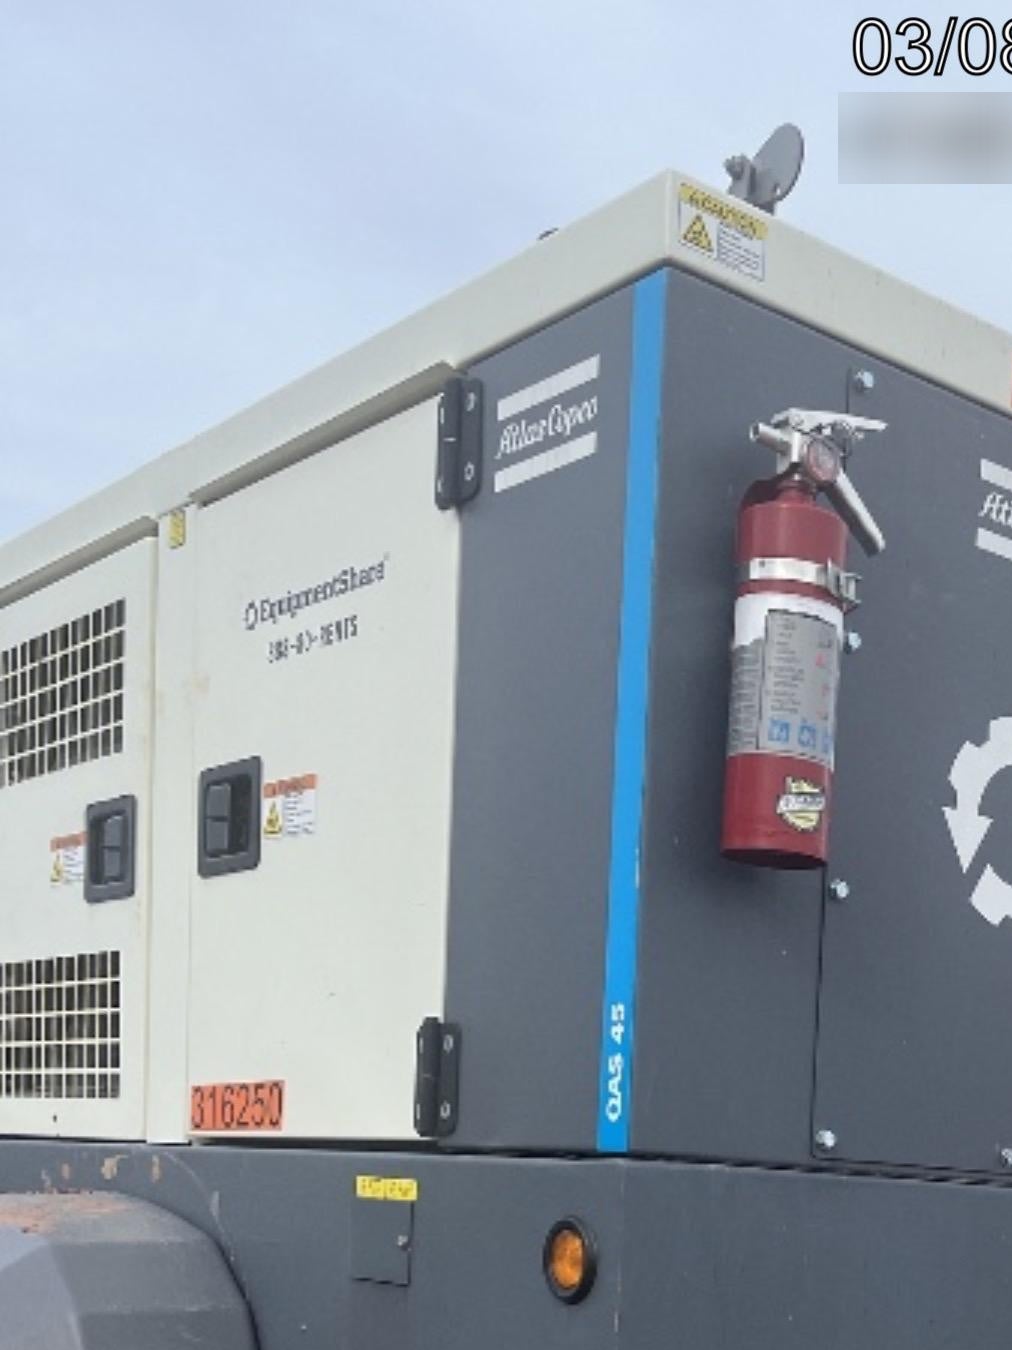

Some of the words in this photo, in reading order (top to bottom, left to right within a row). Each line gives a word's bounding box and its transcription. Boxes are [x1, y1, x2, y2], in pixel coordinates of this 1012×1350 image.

[494, 419, 547, 460] Atlas
[547, 395, 598, 437] Copco
[610, 1002, 625, 1045] 45
[191, 1082, 283, 1129] 316250
[605, 1052, 623, 1123] QAS
